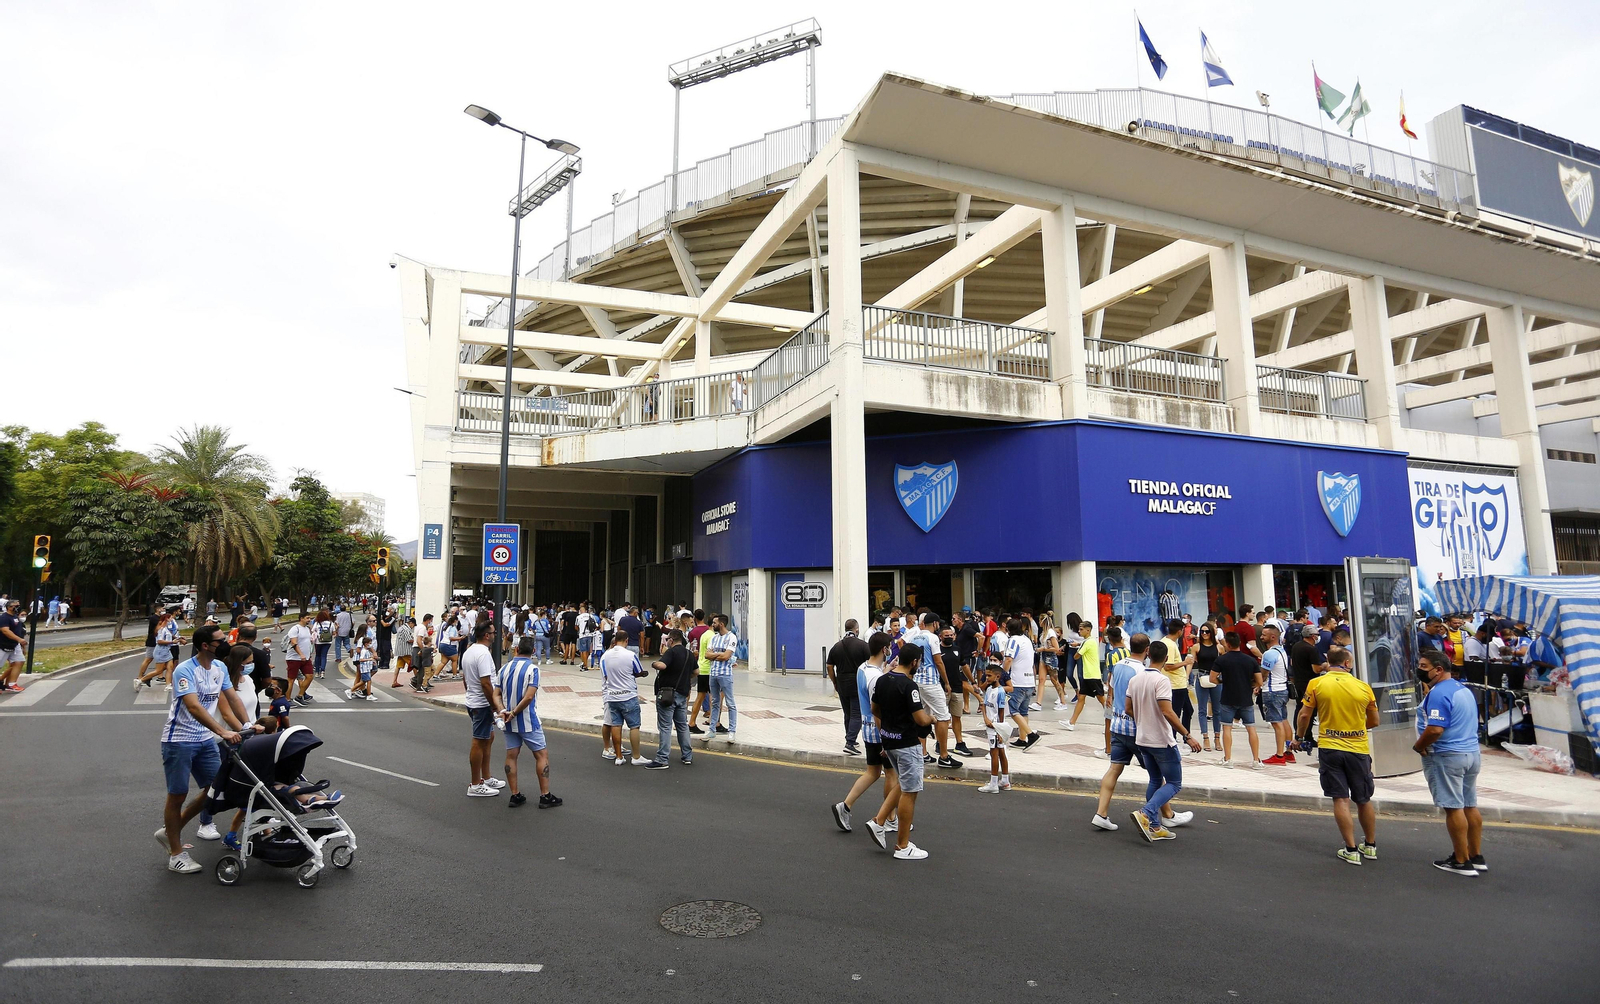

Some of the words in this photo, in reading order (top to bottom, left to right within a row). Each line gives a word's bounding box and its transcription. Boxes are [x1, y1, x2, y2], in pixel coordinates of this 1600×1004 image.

[908, 478, 937, 502] MAAGA
[1129, 479, 1179, 496] TIENDA
[1182, 483, 1232, 499] OFICIAL
[1414, 481, 1442, 497] TIRA
[1445, 483, 1460, 498] DE
[720, 501, 736, 517] STORE
[1148, 499, 1216, 515] MALAGACF
[1415, 497, 1498, 532] GENIO
[427, 528, 440, 536] P4
[495, 551, 508, 559] 30
[785, 585, 824, 602] 80
[1326, 729, 1365, 737] BENAHAVIS
